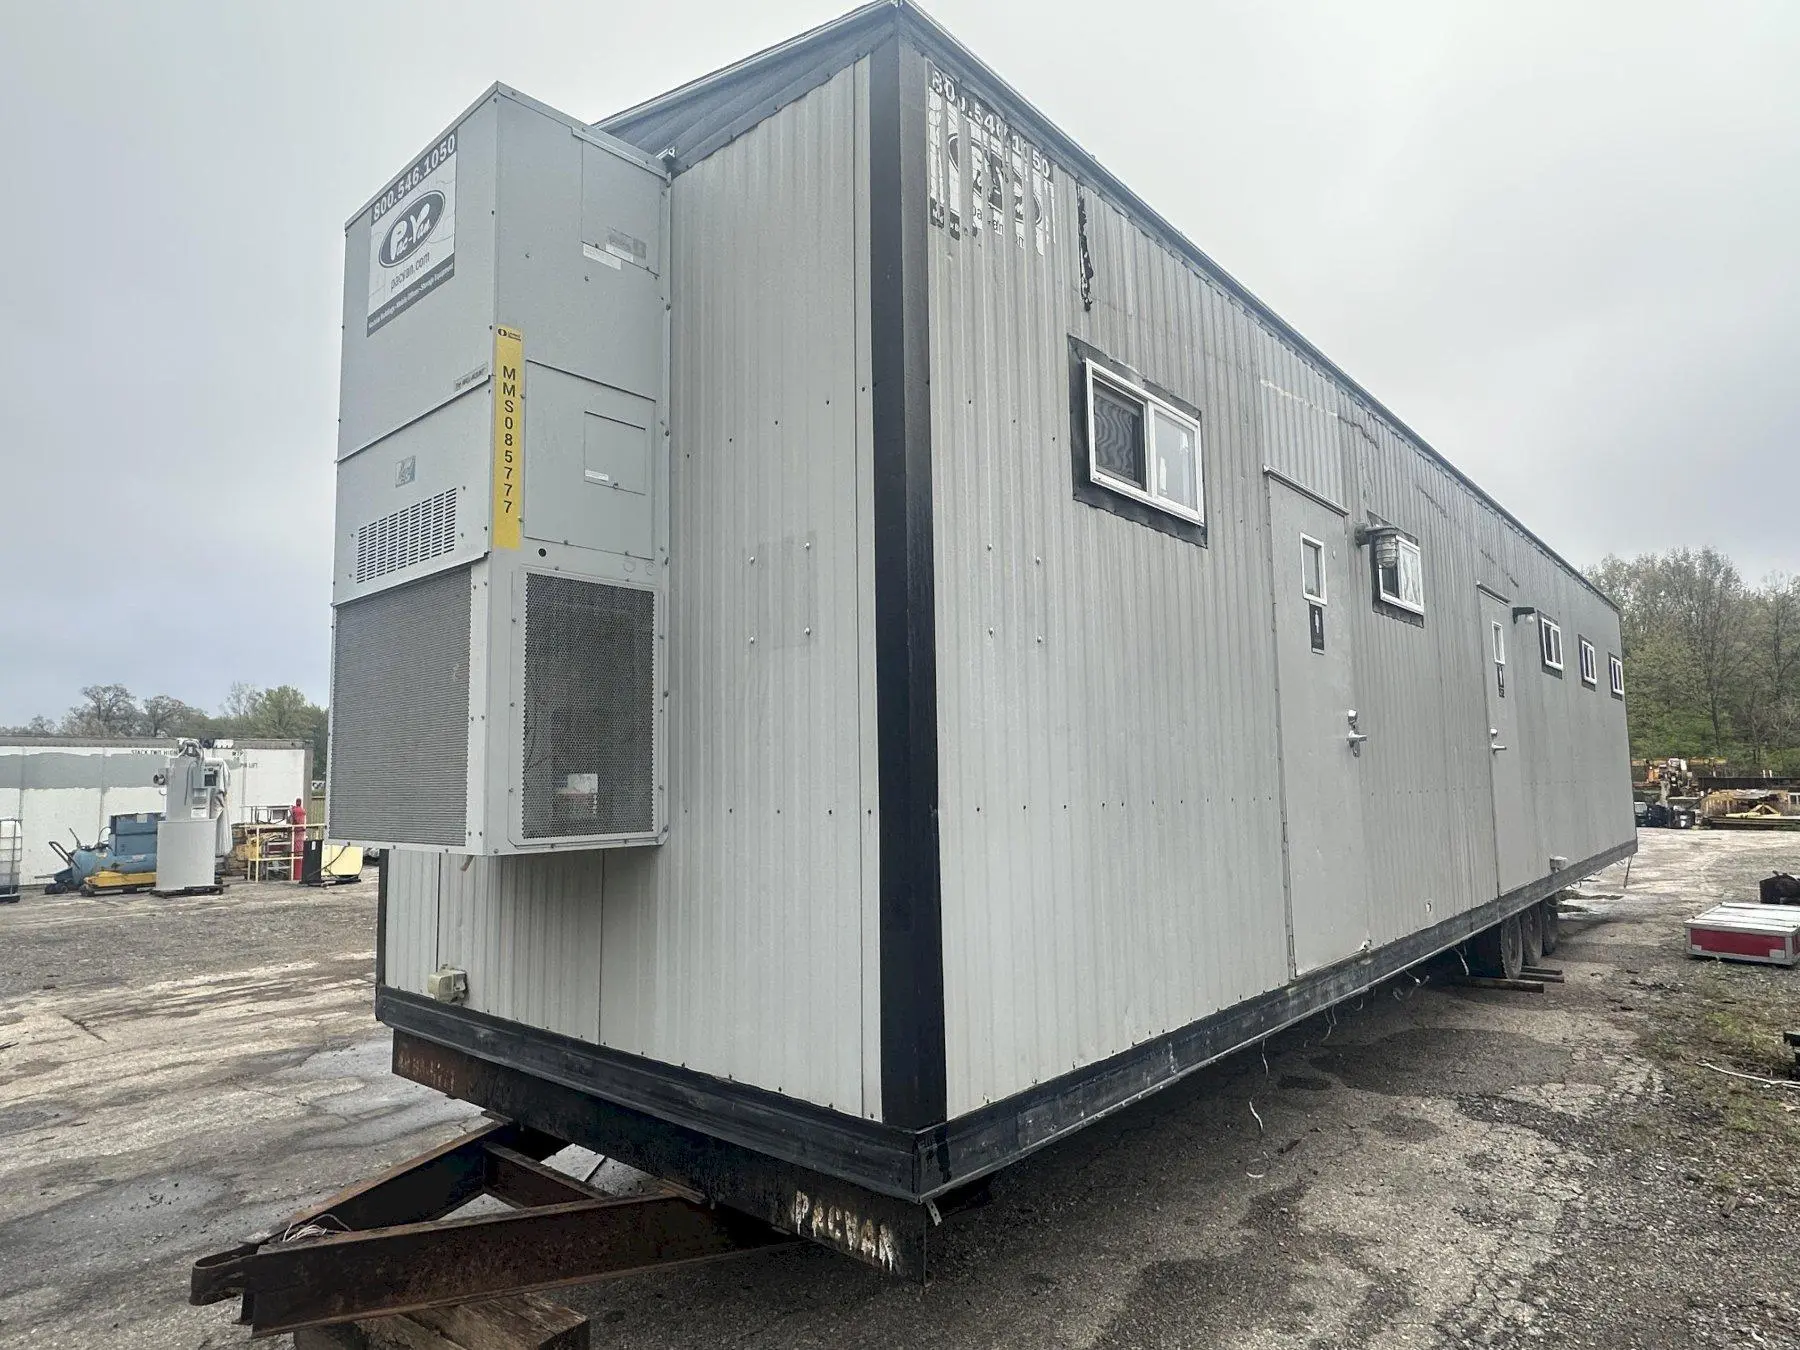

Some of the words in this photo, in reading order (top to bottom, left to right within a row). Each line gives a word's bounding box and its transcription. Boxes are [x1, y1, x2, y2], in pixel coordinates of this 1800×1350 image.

[374, 134, 455, 220] 800.546.1050
[391, 252, 430, 292] pacvan.com
[502, 366, 516, 513] MMS085777
